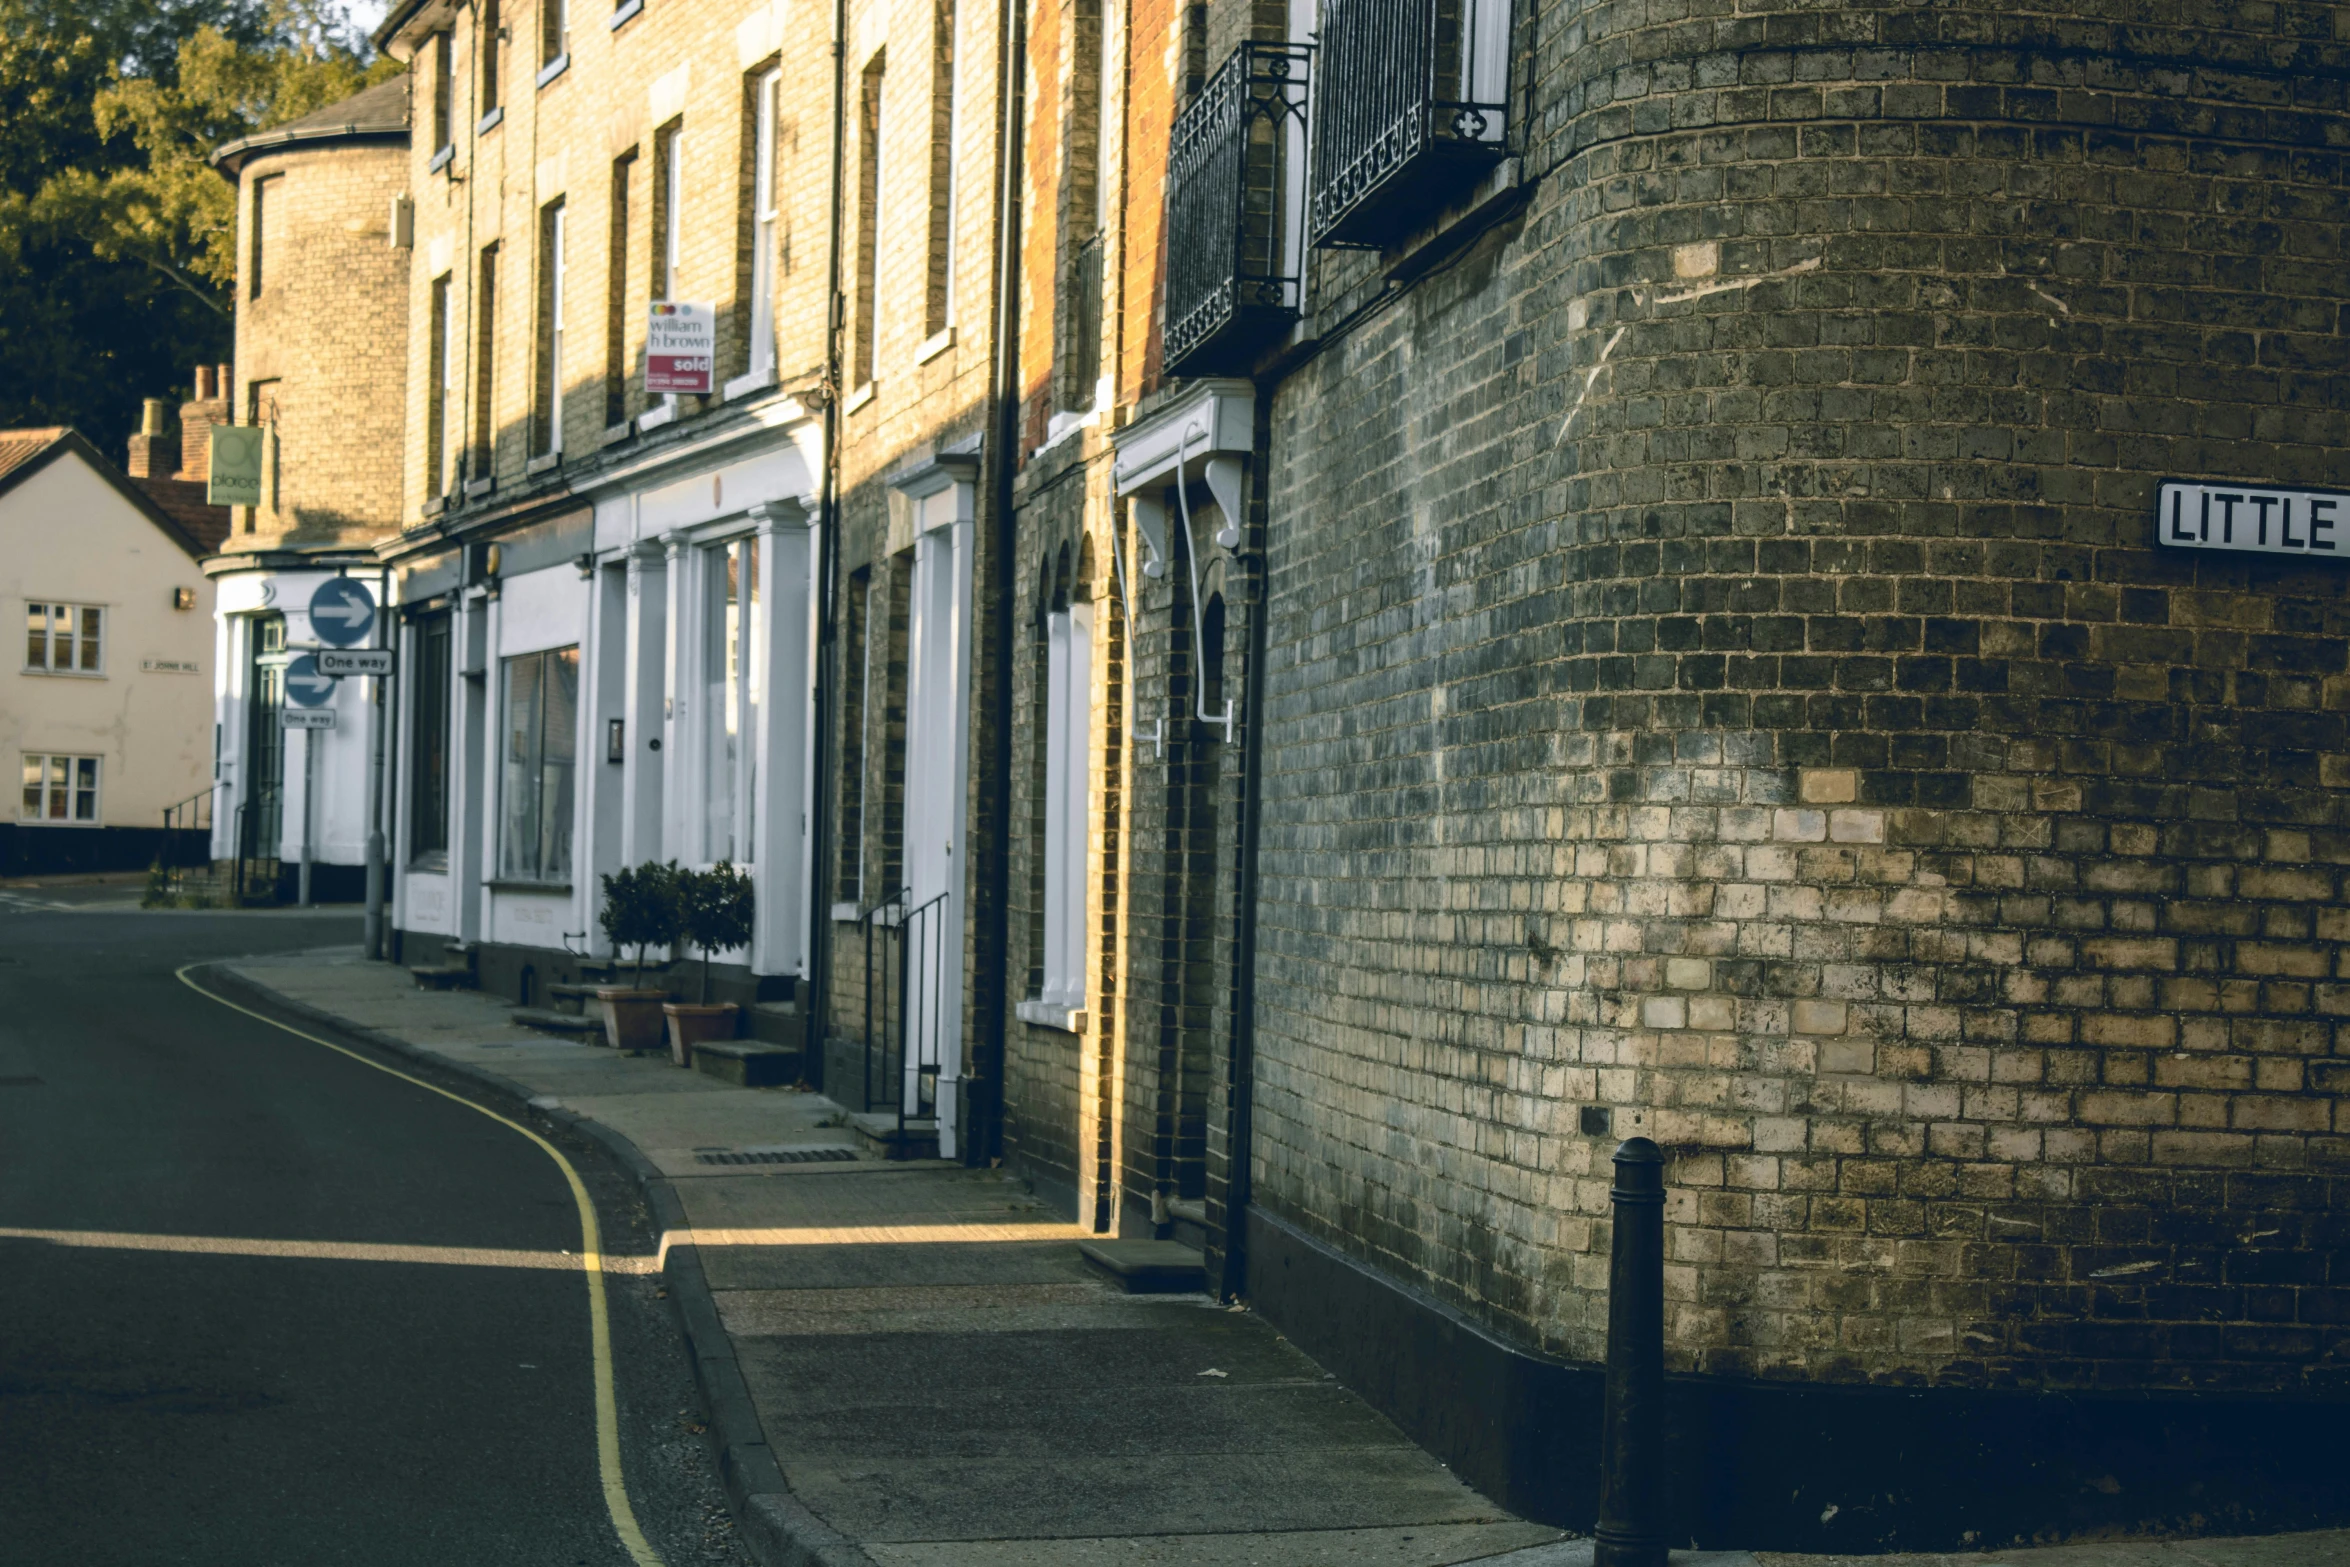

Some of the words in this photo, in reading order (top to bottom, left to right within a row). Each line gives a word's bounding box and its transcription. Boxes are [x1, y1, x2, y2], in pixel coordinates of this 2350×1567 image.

[650, 318, 702, 333] william
[650, 333, 660, 348] h
[663, 333, 710, 348] brown
[673, 357, 709, 372] sold
[2172, 490, 2337, 550] LITTLE
[182, 662, 200, 672] HILL
[324, 656, 353, 668] One
[358, 658, 386, 670] way
[285, 714, 306, 723] One
[310, 715, 331, 725] way
